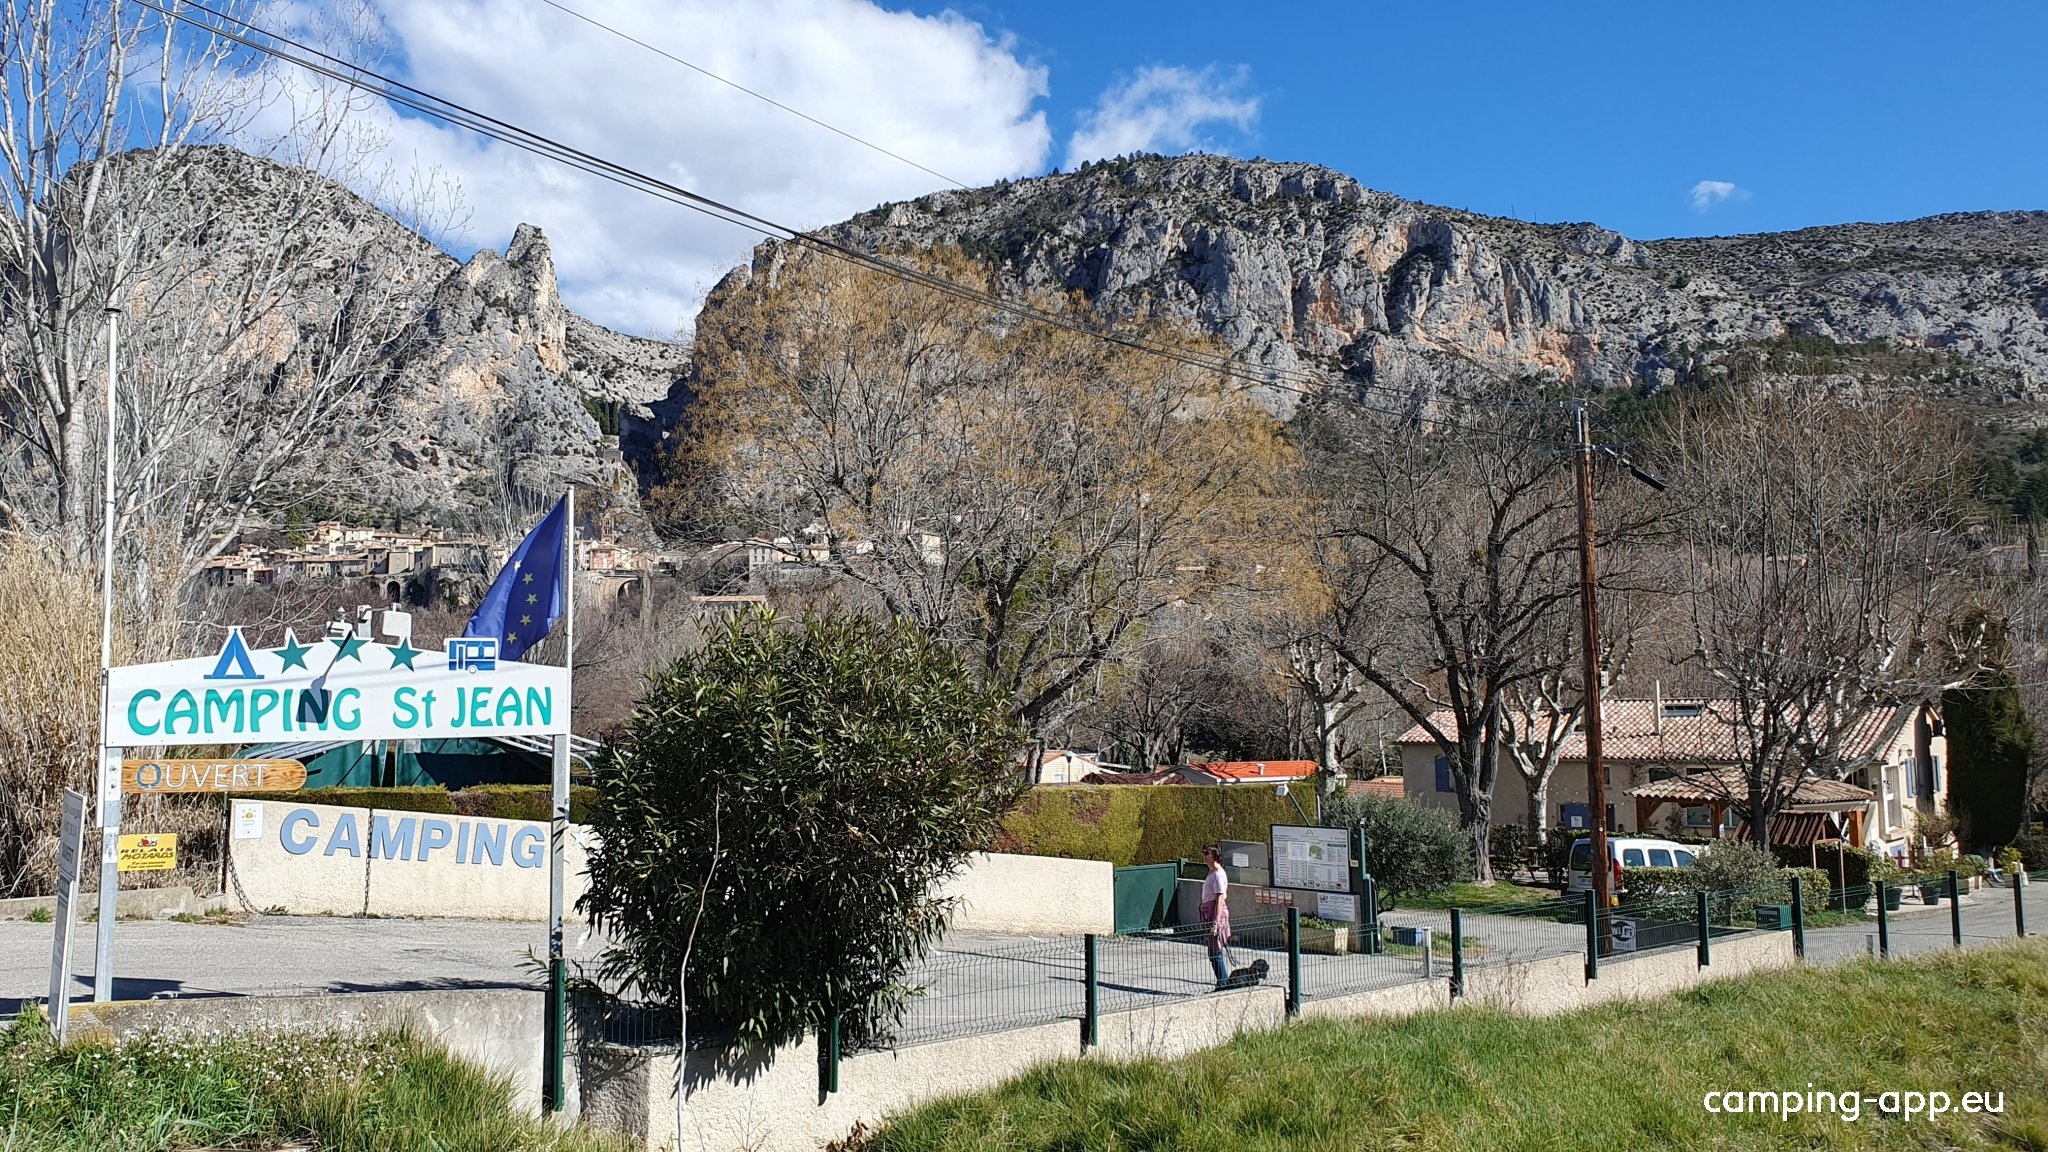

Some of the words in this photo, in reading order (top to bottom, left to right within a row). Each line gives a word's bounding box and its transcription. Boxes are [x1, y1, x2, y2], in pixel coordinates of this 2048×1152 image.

[127, 687, 362, 736] CAMPING
[392, 686, 437, 730] St
[450, 686, 552, 729] JEAN
[136, 763, 269, 790] OUVERT
[120, 852, 174, 860] MOTARDS
[279, 808, 546, 869] CAMPING
